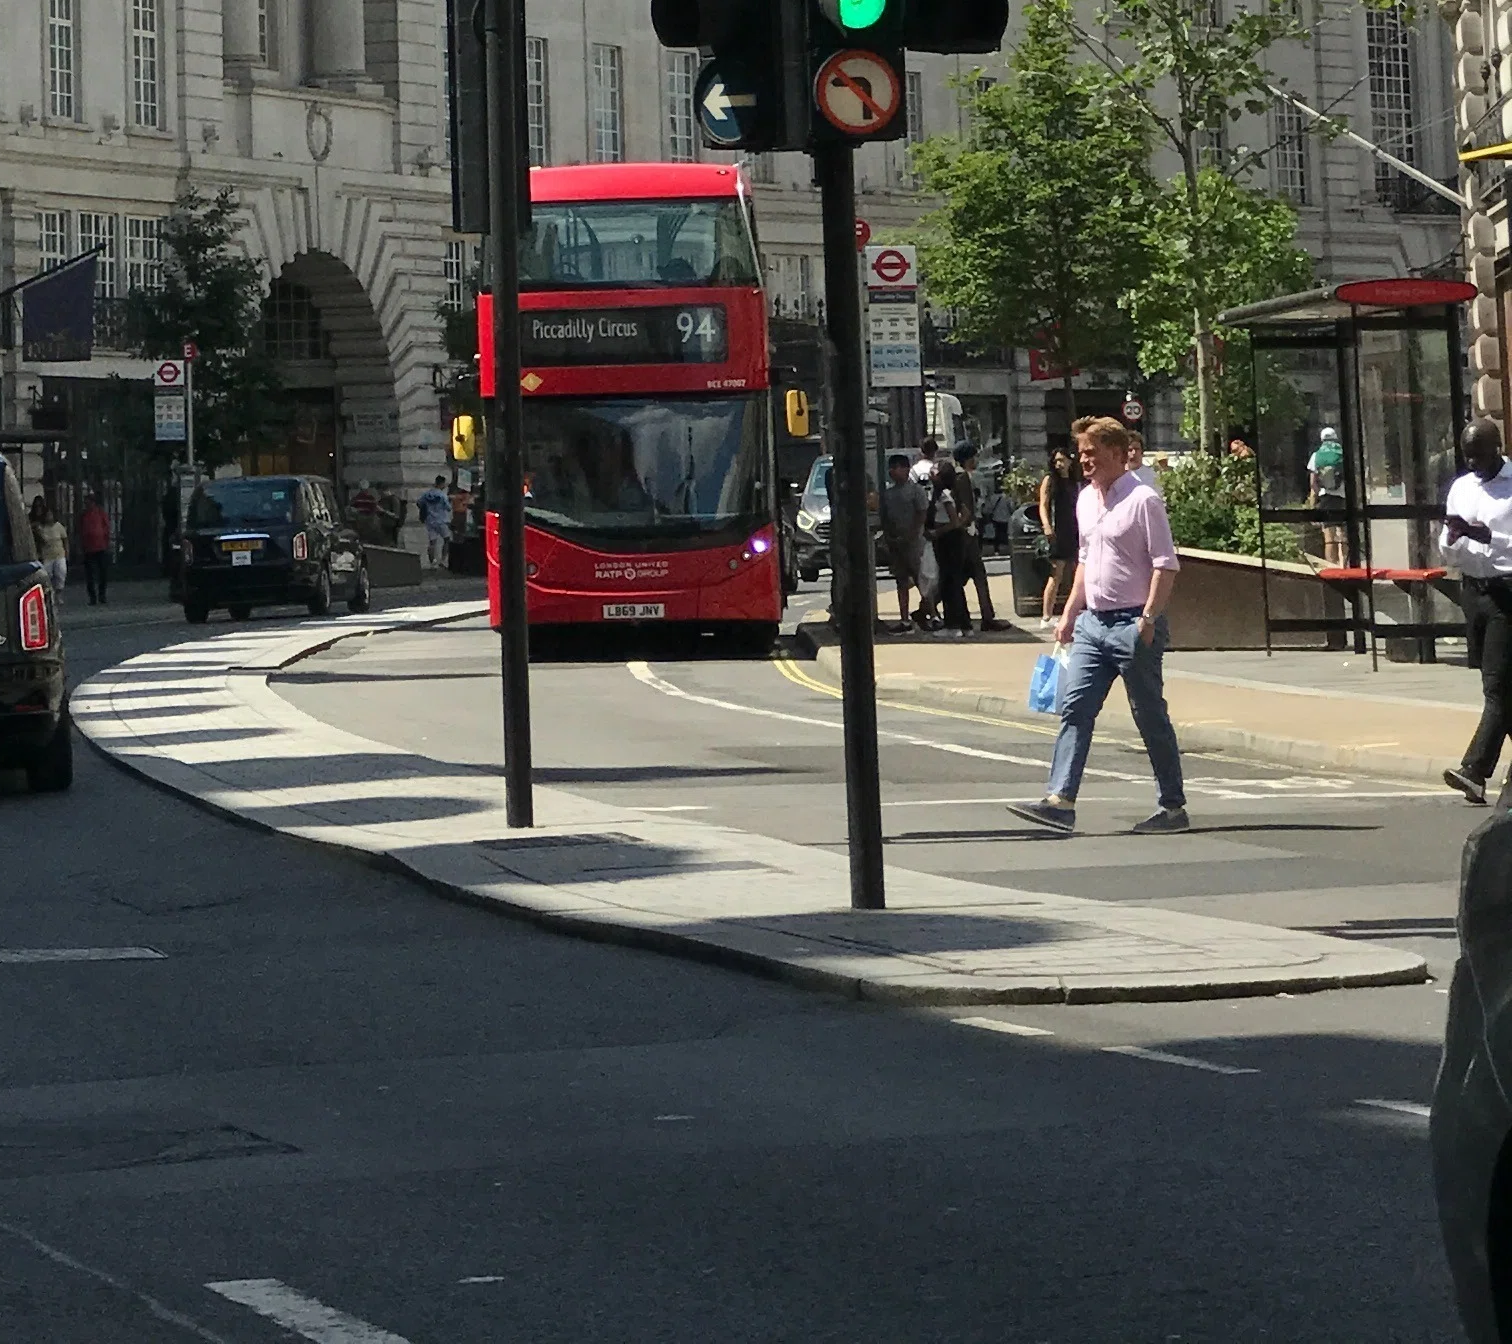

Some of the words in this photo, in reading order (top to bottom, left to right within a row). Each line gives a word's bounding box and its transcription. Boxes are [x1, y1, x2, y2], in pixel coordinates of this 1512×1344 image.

[532, 318, 594, 343] Piccadilly
[598, 317, 638, 337] Circus
[676, 312, 716, 343] 94
[183, 343, 192, 358] E
[1125, 405, 1141, 416] 20
[594, 562, 632, 570] LONDON
[635, 560, 669, 568] UNITED
[595, 570, 623, 579] RATP
[637, 569, 669, 578] GROUP
